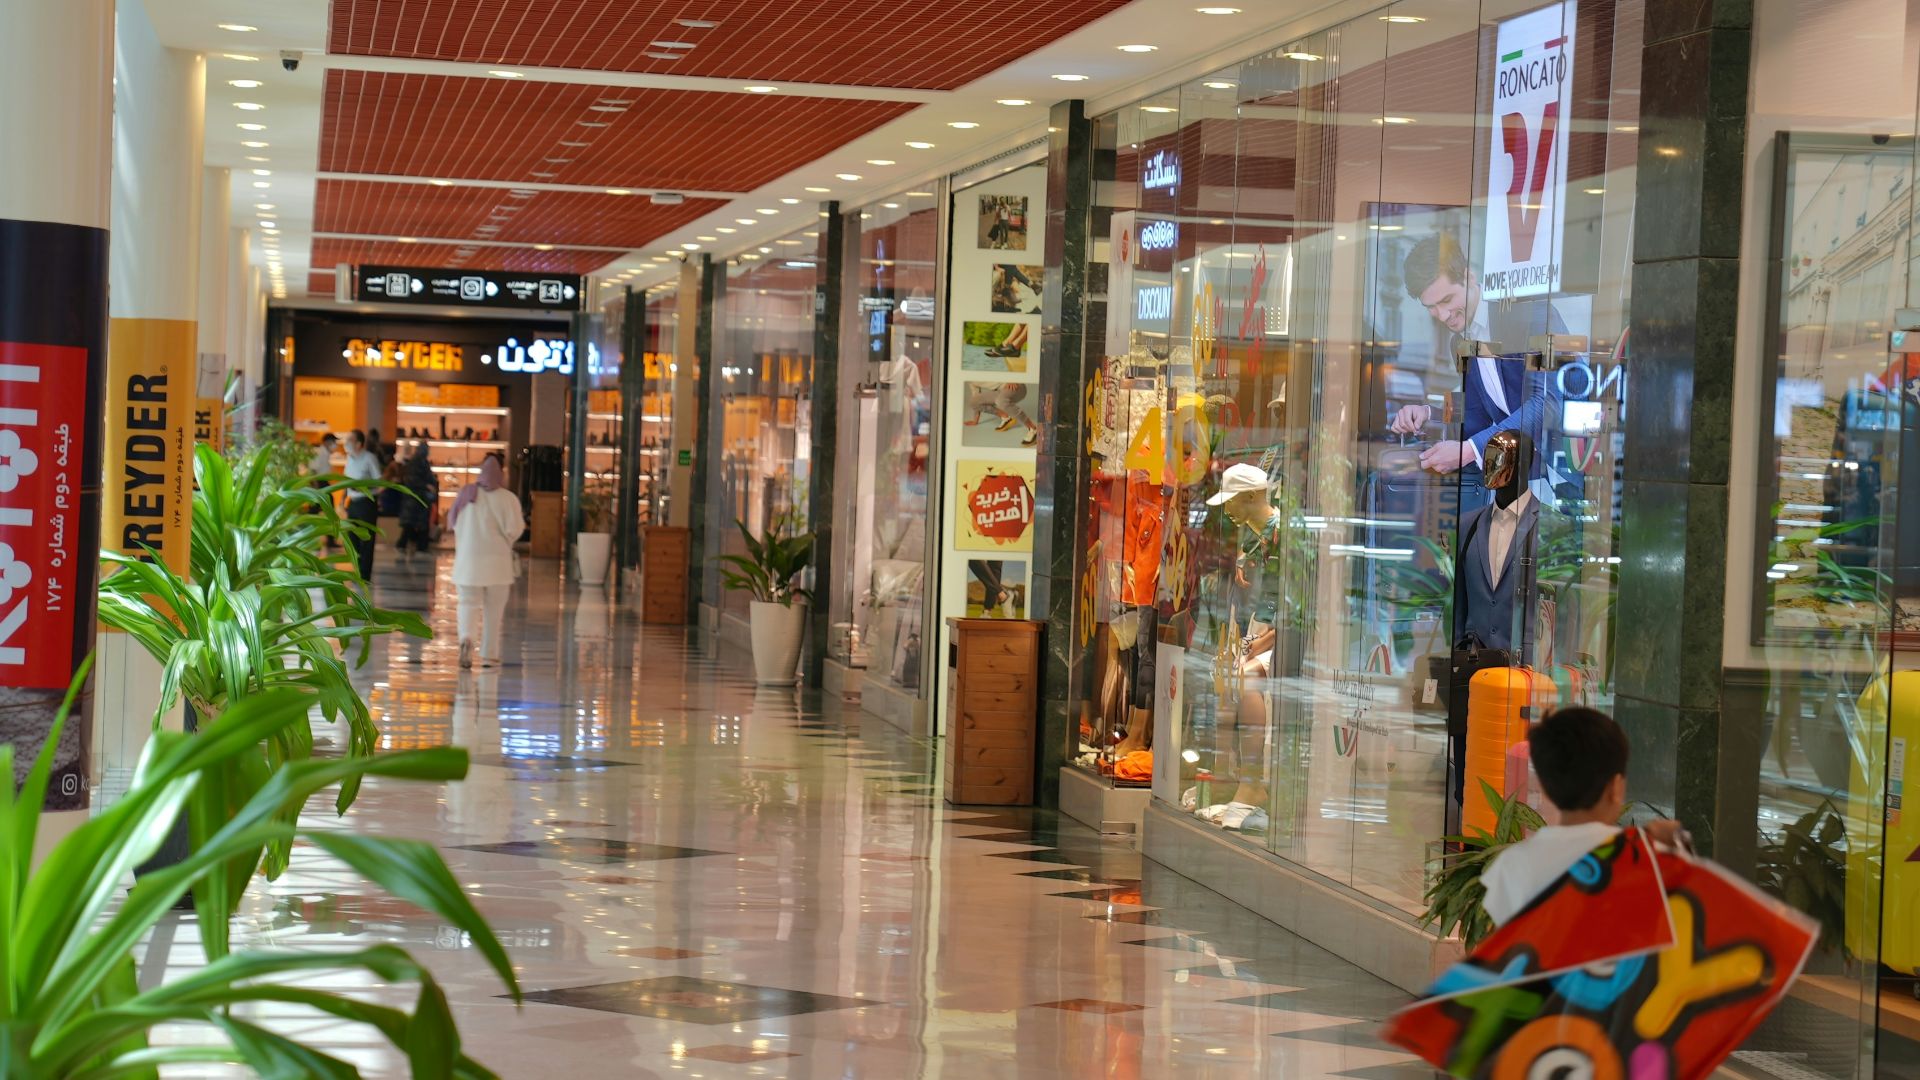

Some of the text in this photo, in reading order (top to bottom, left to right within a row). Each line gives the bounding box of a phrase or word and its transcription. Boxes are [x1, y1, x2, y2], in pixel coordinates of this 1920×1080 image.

[1499, 52, 1567, 100] RONCATO
[1484, 263, 1559, 292] MOVE YOUR DREAM
[175, 425, 185, 451] طبقه
[123, 373, 168, 564] REYDER
[175, 452, 185, 474] دوم
[172, 474, 183, 505] شماره
[975, 486, 1011, 507] خرید
[46, 422, 72, 612] طبقه دوم شماره ۱۷۴
[976, 506, 1021, 528] هدیه
